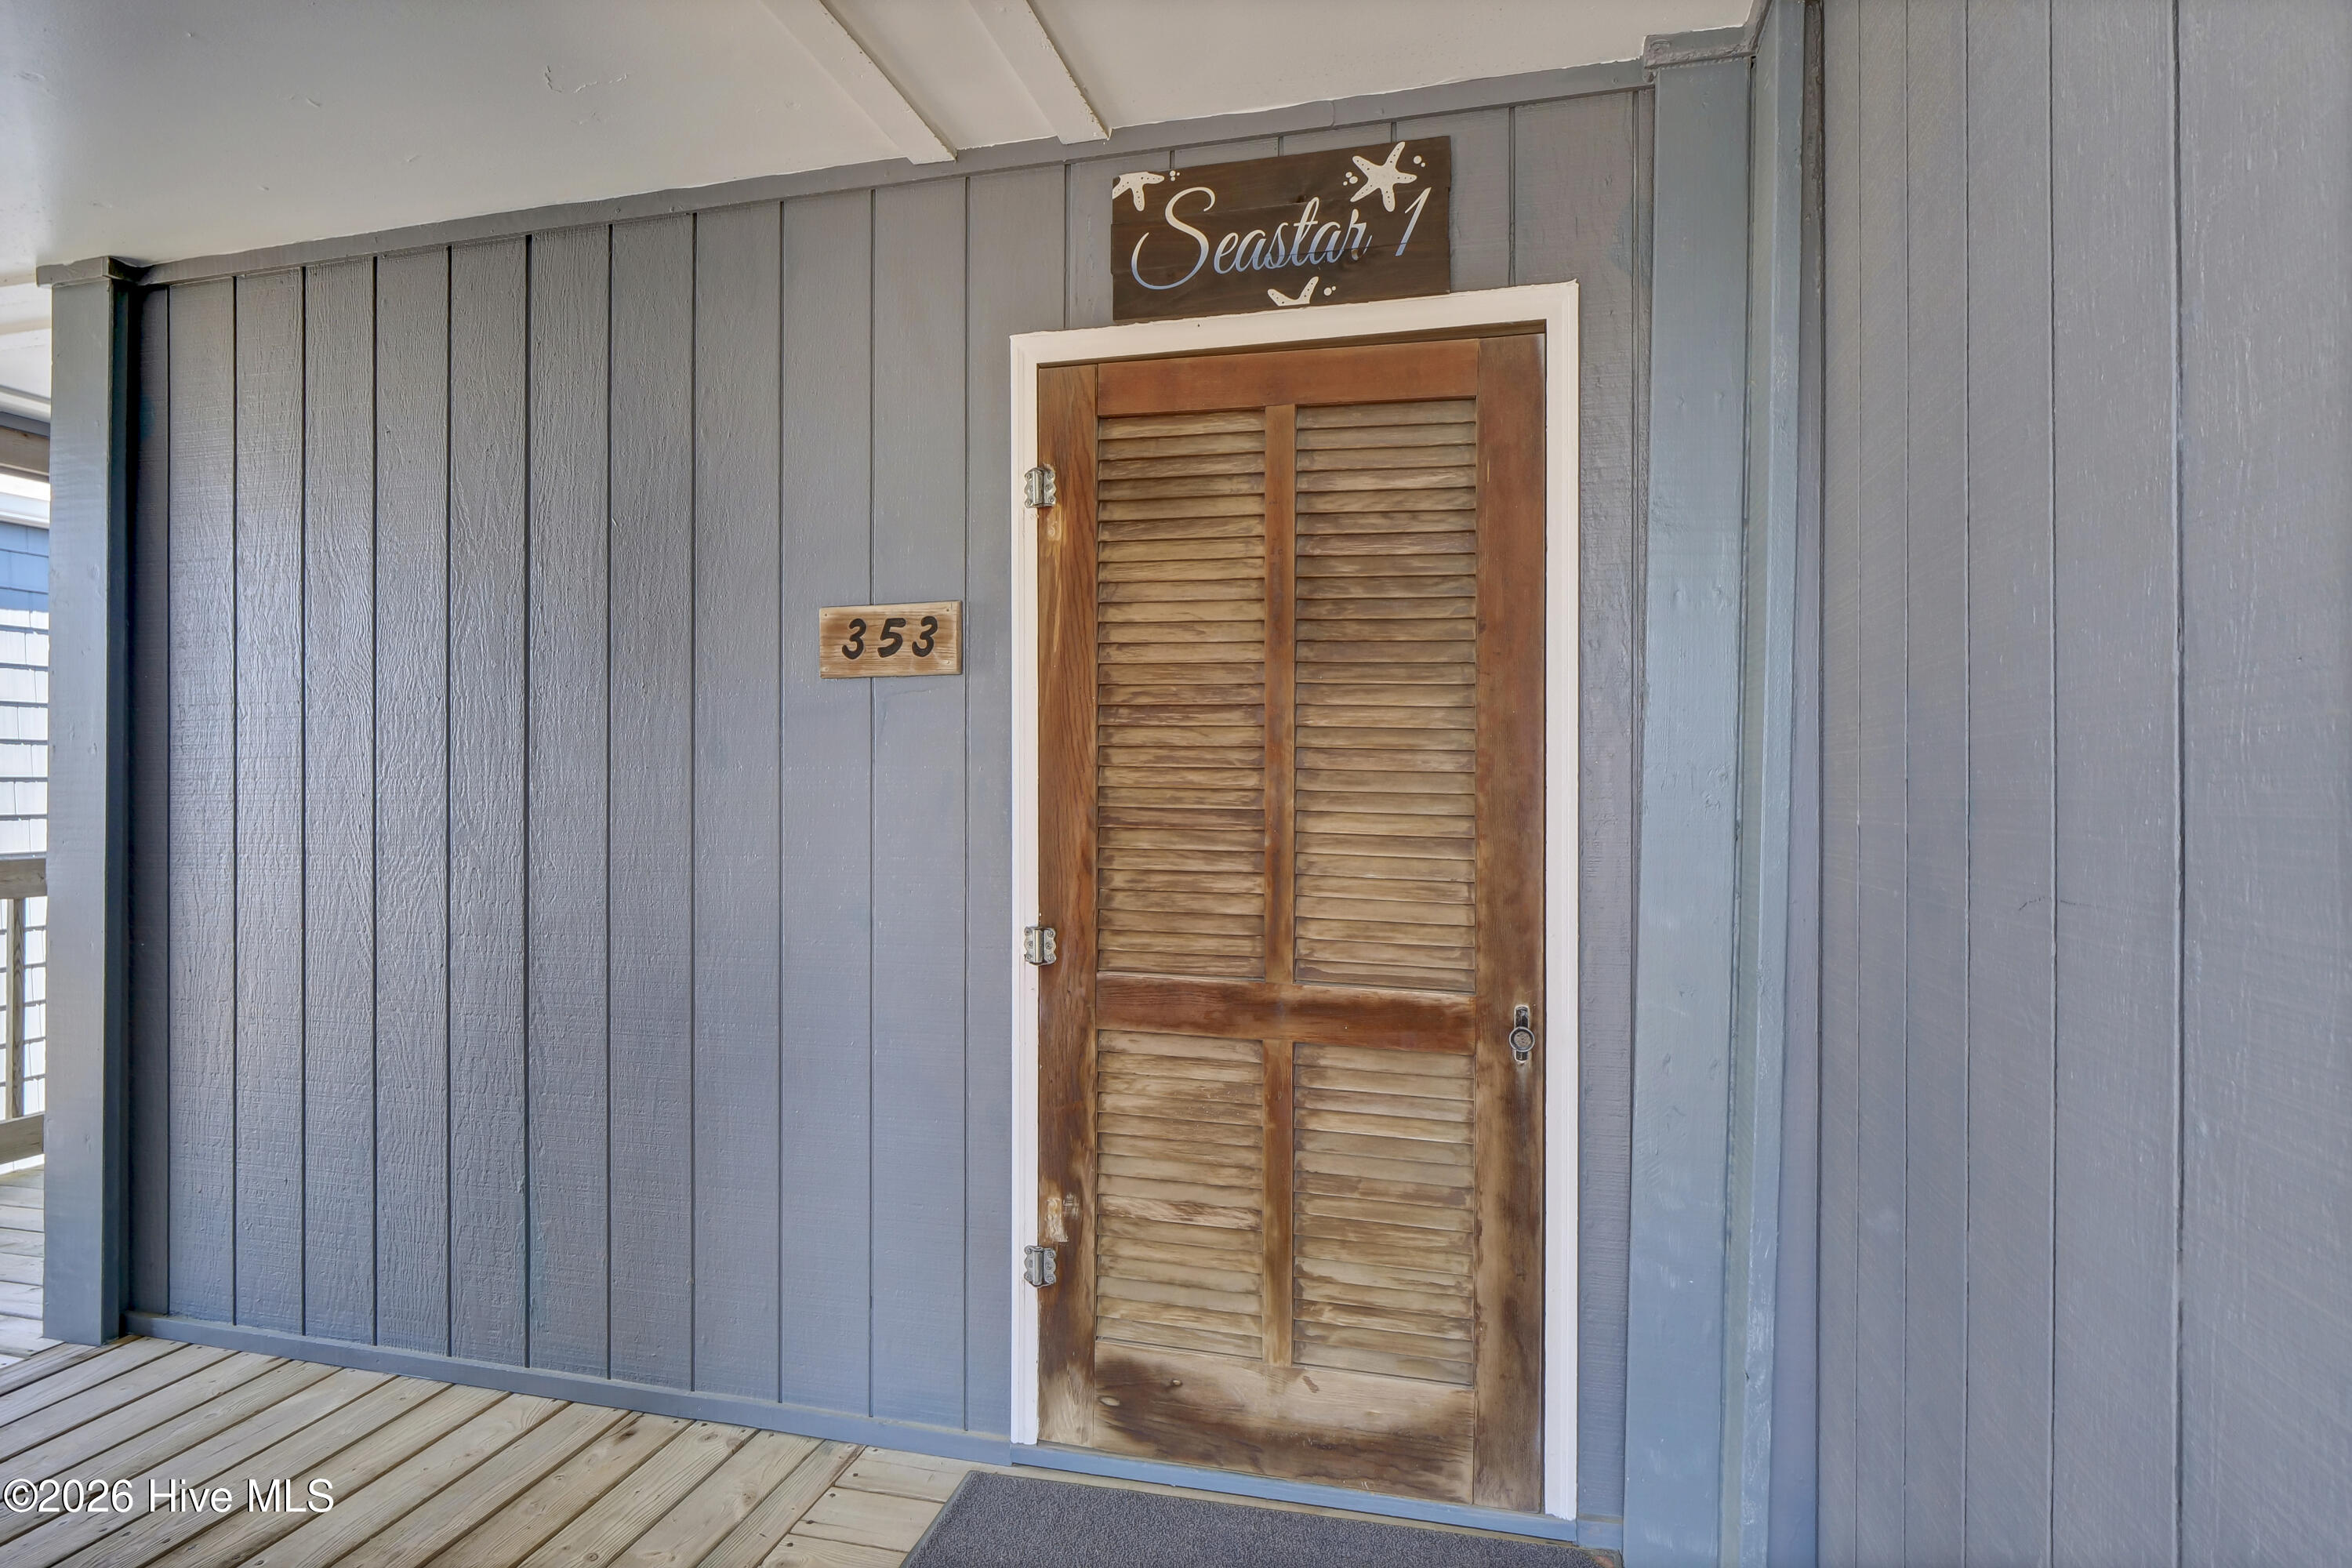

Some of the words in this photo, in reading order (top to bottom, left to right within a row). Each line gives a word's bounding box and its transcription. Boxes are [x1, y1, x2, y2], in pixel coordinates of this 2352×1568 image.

[1131, 187, 1372, 290] Seastar
[1396, 187, 1432, 257] 1
[842, 615, 938, 659] 353
